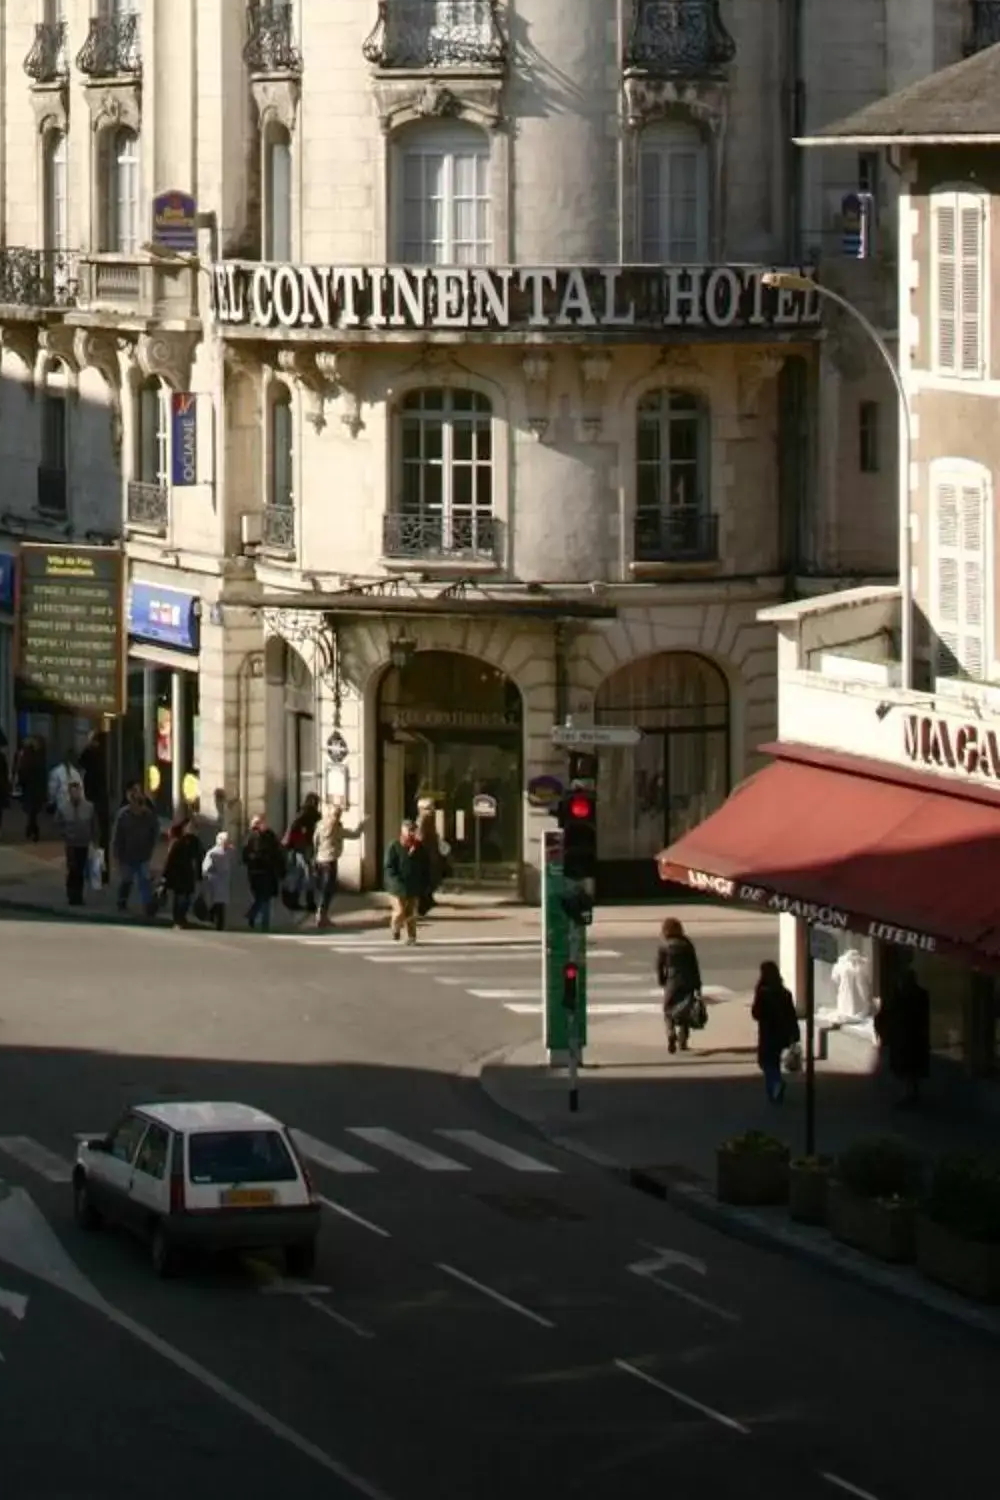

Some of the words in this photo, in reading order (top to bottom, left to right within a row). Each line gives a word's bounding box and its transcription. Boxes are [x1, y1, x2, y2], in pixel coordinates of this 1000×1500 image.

[252, 265, 636, 327] CONTINENTAL
[664, 266, 821, 326] HOTEL
[688, 869, 736, 897] LINGE
[739, 885, 765, 902] DE
[768, 894, 850, 928] MAISON
[867, 921, 938, 952] LITERIE
